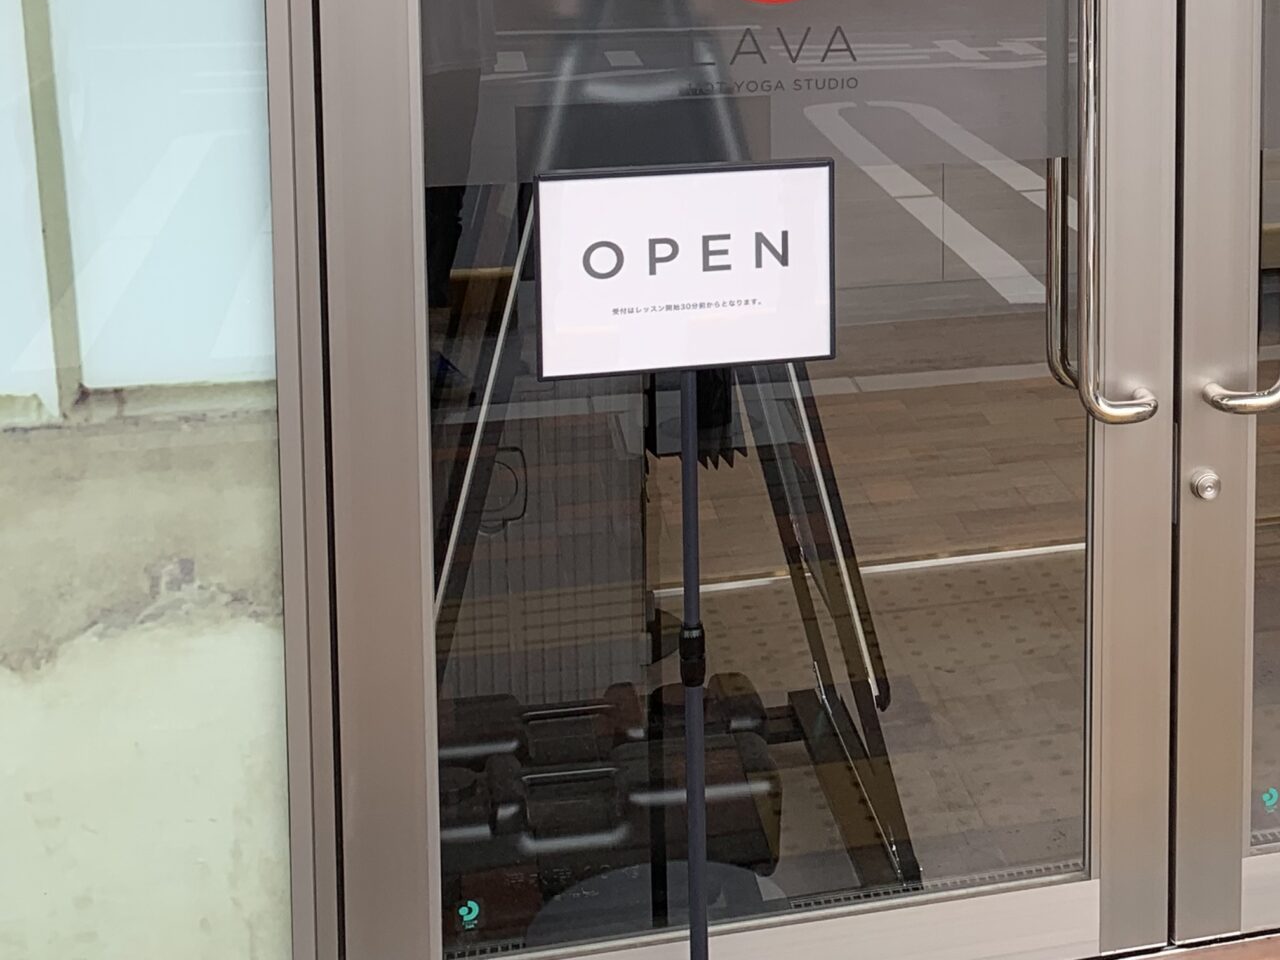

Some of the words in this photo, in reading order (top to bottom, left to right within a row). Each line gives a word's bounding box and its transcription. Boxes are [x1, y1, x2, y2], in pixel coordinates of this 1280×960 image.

[734, 79, 785, 93] YOGA
[793, 77, 858, 91] STUDIO
[582, 230, 789, 280] OPEN
